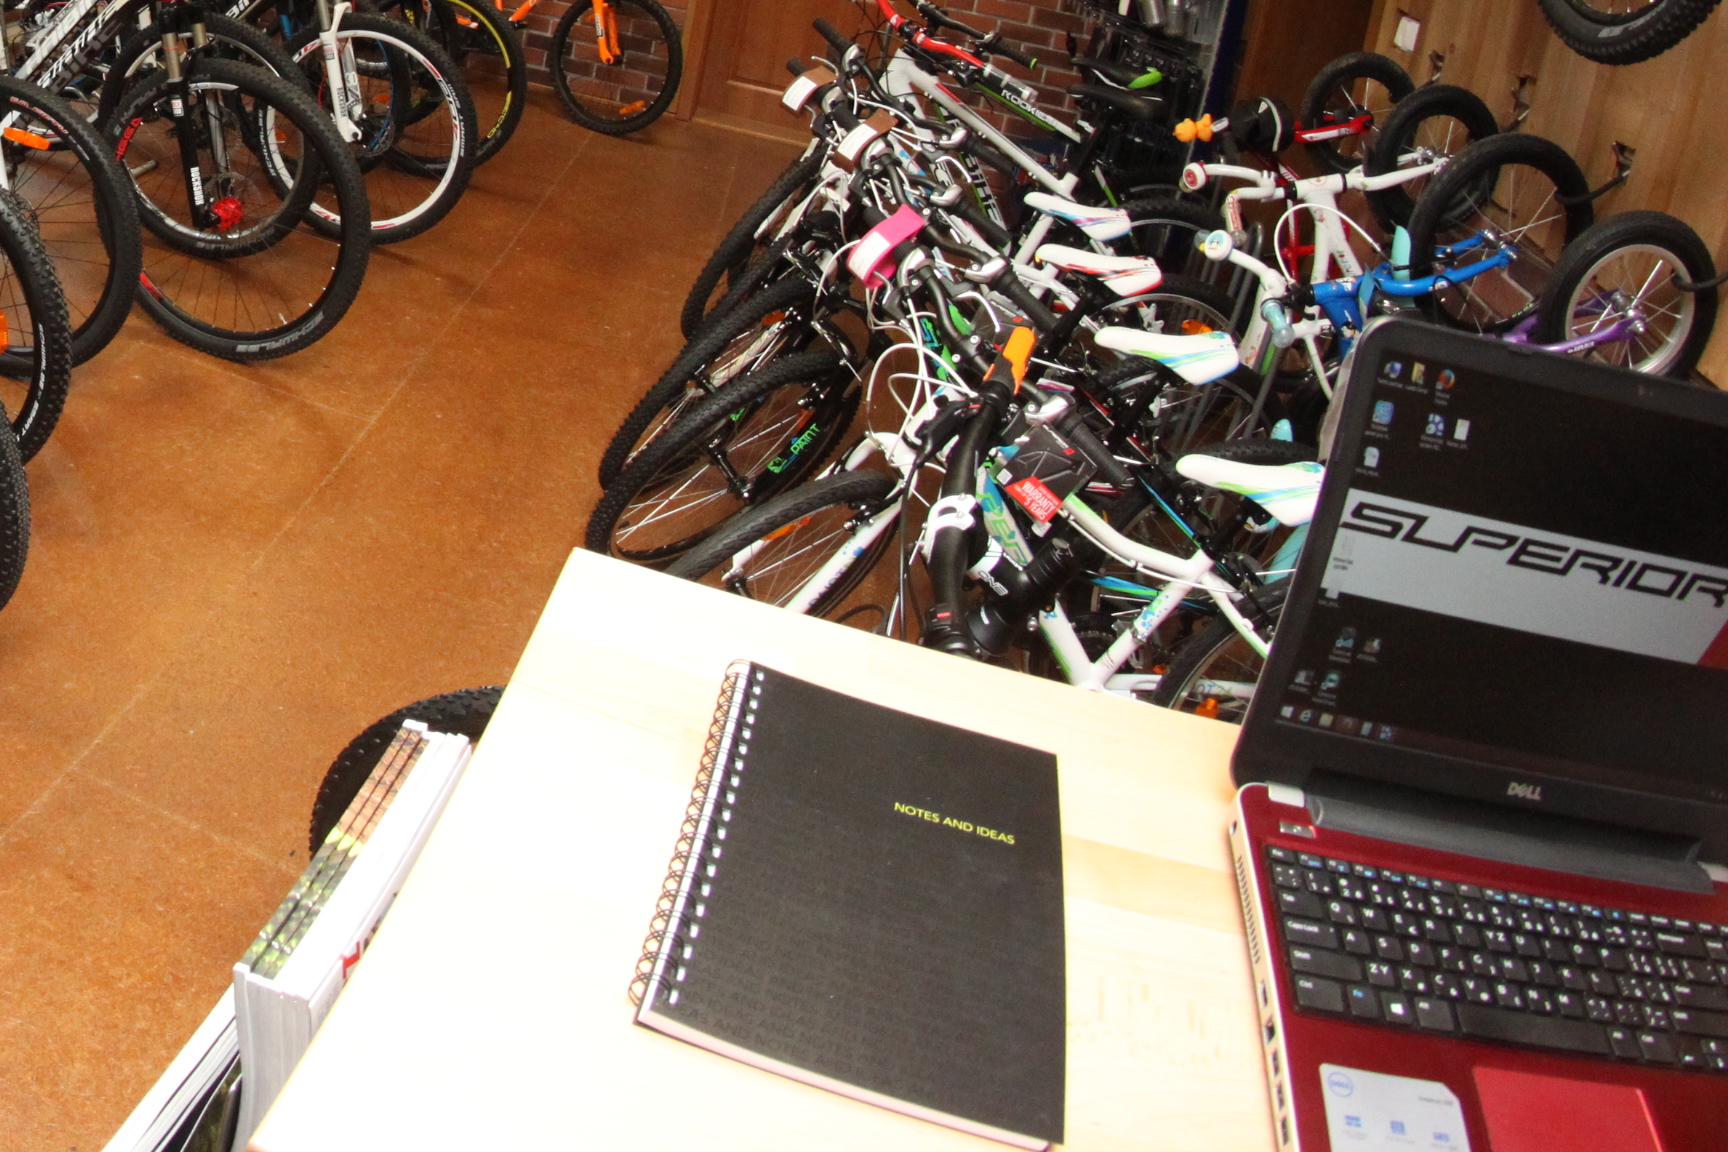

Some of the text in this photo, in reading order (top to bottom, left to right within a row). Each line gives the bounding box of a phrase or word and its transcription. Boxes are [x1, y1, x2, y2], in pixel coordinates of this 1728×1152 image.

[189, 166, 205, 206] ROCKSHOX
[1021, 481, 1057, 514] WARRANTY
[1029, 503, 1048, 521] YEARS
[1339, 501, 1728, 608] SUPERIOR
[978, 570, 1009, 596] ONE
[1506, 781, 1542, 801] DELL
[894, 802, 1016, 845] NOTES AND IDEAS
